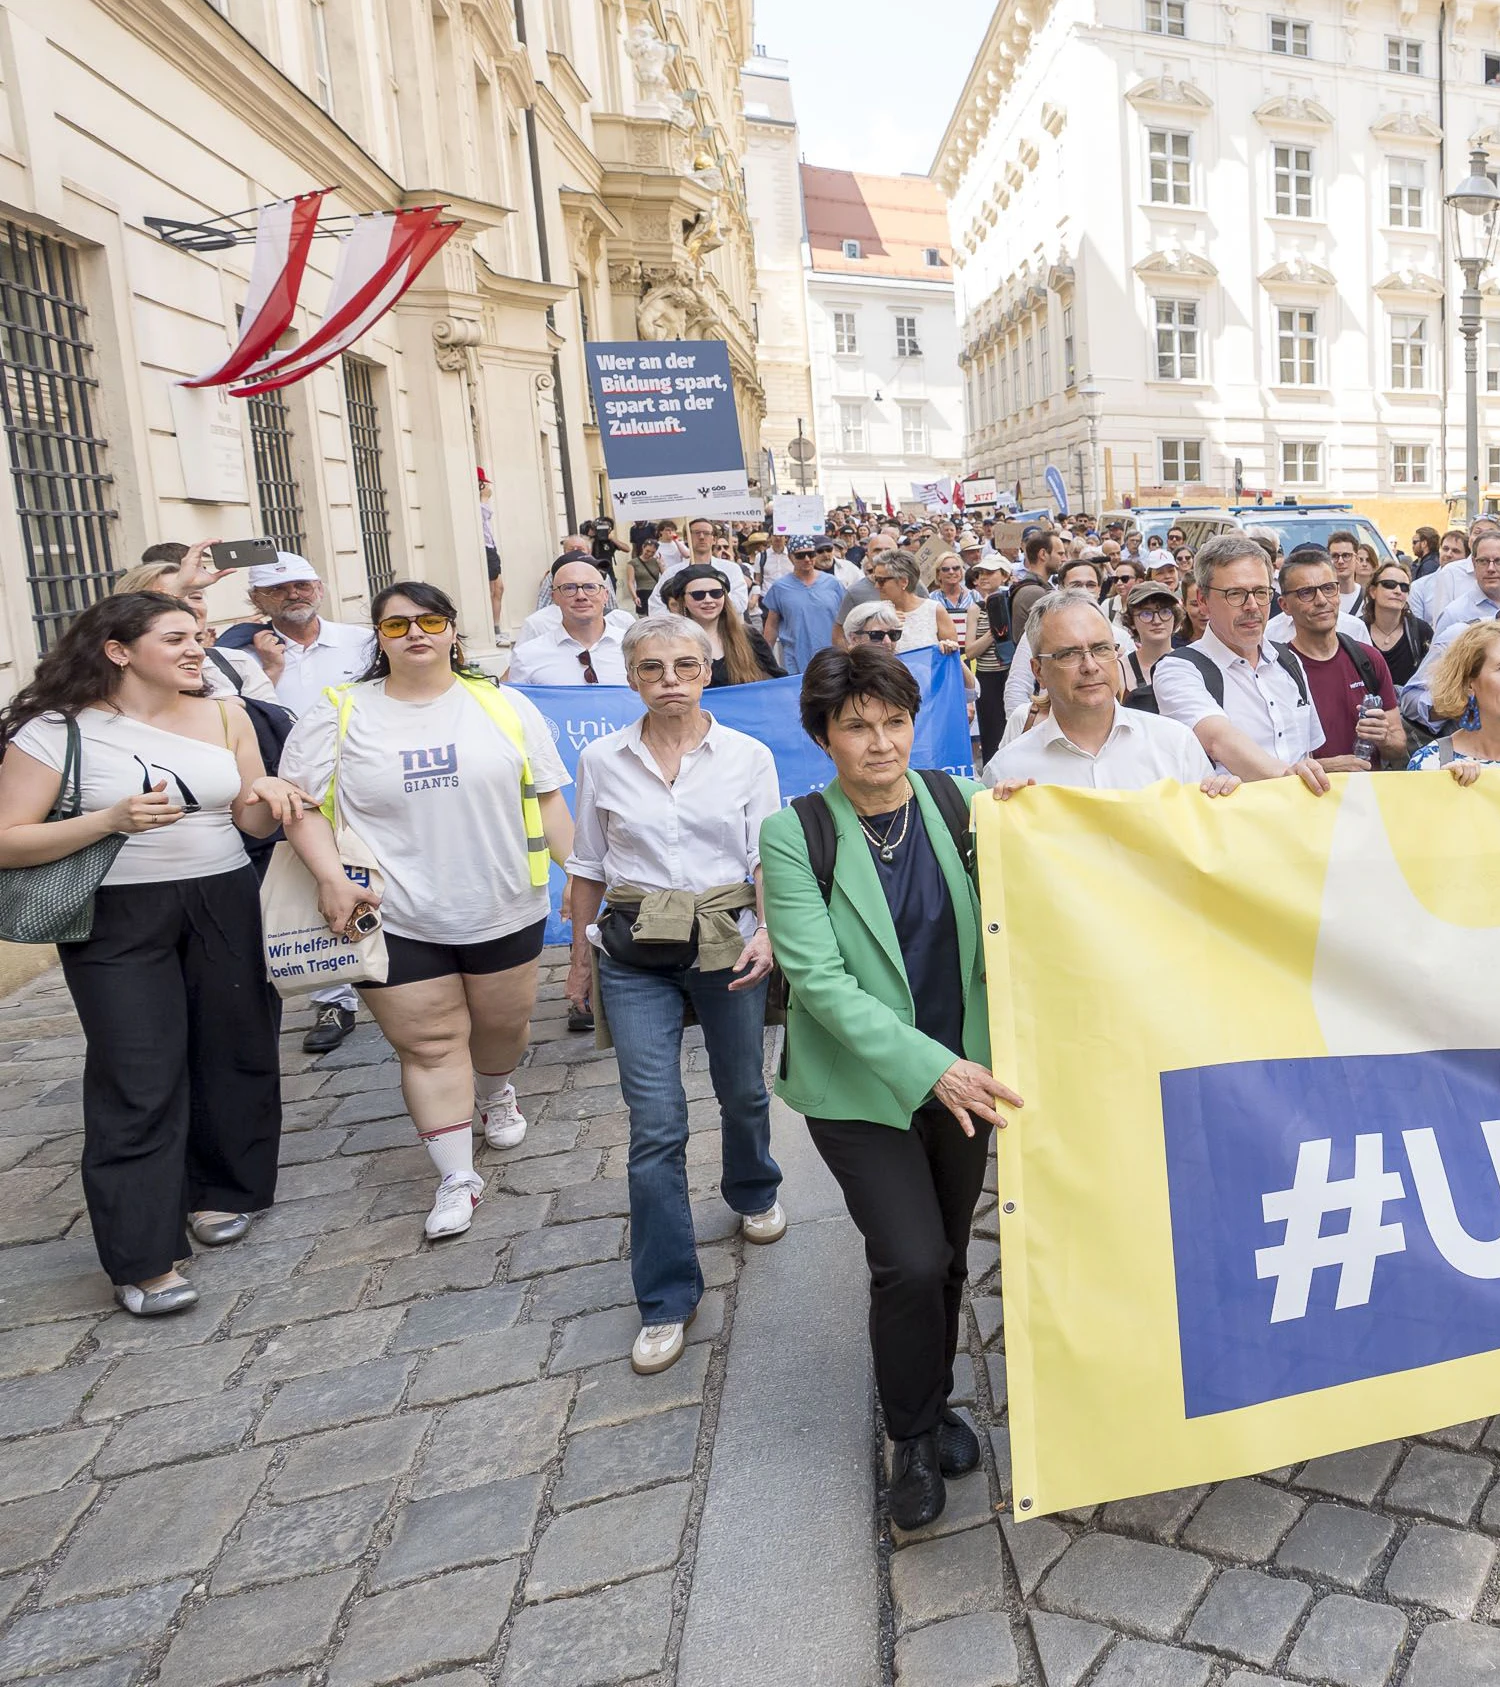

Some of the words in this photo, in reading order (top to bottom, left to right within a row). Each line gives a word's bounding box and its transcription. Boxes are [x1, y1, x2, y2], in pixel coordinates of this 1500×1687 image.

[596, 354, 634, 370] Wer
[638, 356, 662, 370] an
[665, 352, 696, 369] der
[600, 375, 672, 394] Bildung
[675, 374, 728, 393] spart,
[605, 398, 656, 418] spart
[658, 399, 681, 412] an
[684, 395, 714, 410] der
[608, 416, 686, 436] Zukunft.
[404, 776, 459, 793] GIANTS
[268, 942, 292, 958] Wir
[294, 936, 338, 954] helfen
[270, 962, 304, 978] beim
[307, 954, 359, 973] Tragen.
